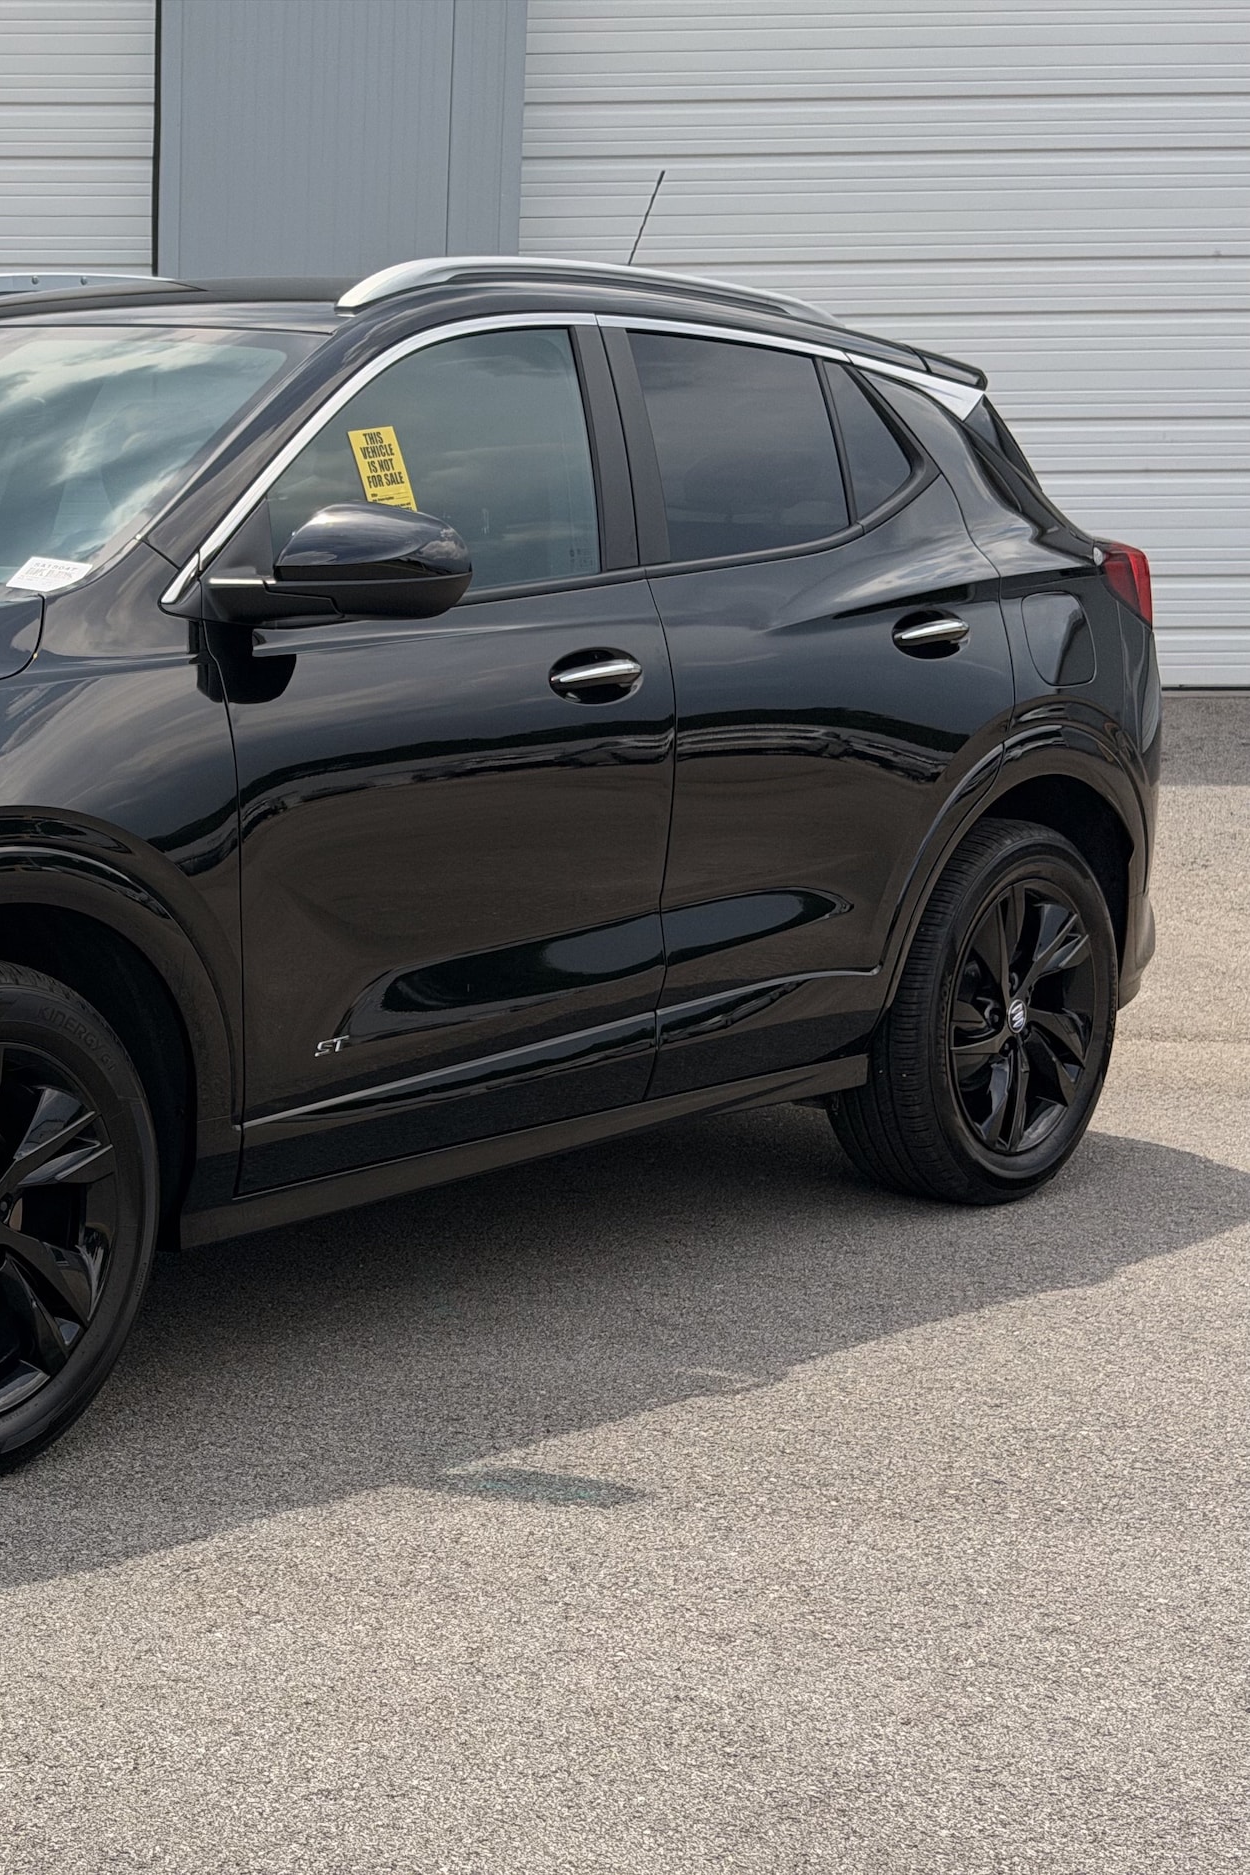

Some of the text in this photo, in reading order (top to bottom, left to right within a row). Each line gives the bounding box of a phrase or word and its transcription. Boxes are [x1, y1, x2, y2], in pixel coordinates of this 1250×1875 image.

[362, 431, 384, 446] THIS
[360, 443, 395, 460] VEHICLE
[367, 458, 395, 474] IS NOT
[366, 471, 405, 489] FOR SALE
[314, 1035, 350, 1057] ST
